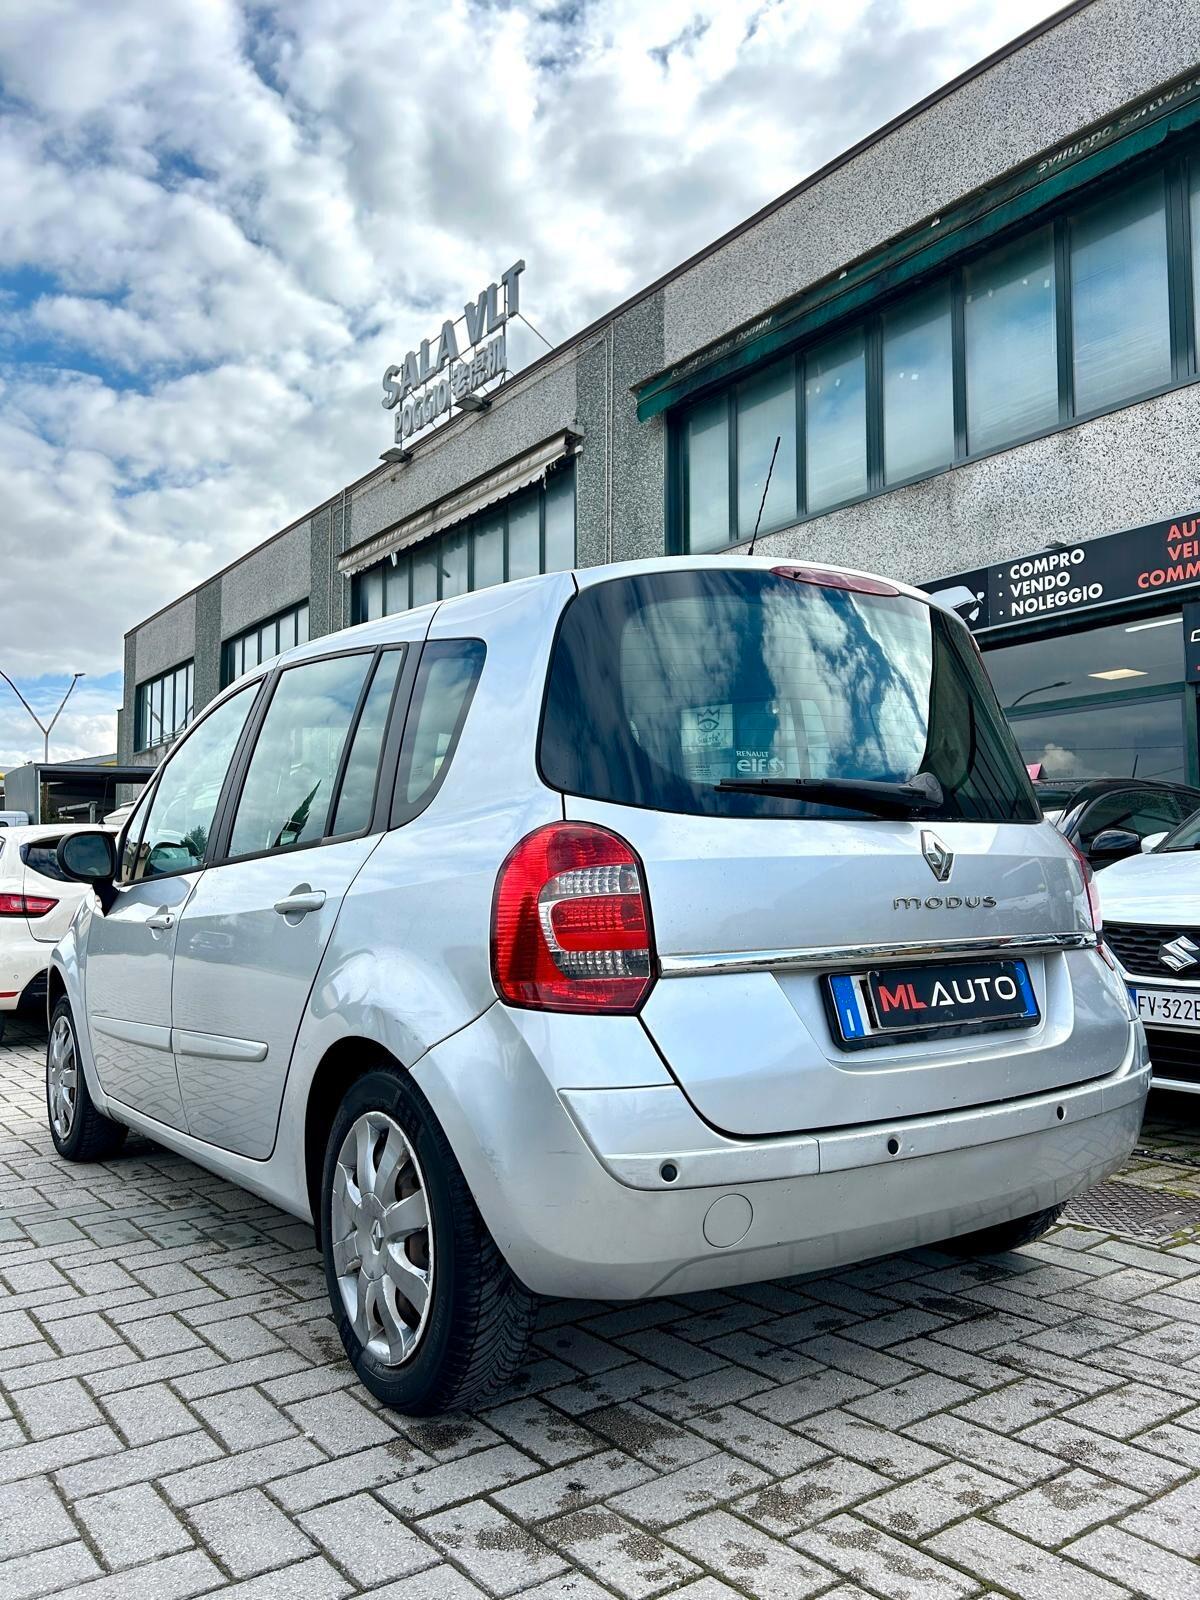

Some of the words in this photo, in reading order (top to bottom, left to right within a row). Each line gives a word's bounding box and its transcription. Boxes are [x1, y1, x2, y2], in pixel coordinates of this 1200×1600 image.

[381, 319, 459, 410] SALA
[464, 258, 526, 346] VLT
[394, 378, 452, 444] POGGIO
[1167, 518, 1200, 542] AU
[1009, 548, 1086, 580] COMPRO
[1137, 561, 1200, 589] COMM
[1010, 571, 1071, 598] VENDO
[1010, 583, 1104, 617] NOLEGGIO
[735, 750, 769, 758] RENAULT
[736, 758, 767, 772] elf
